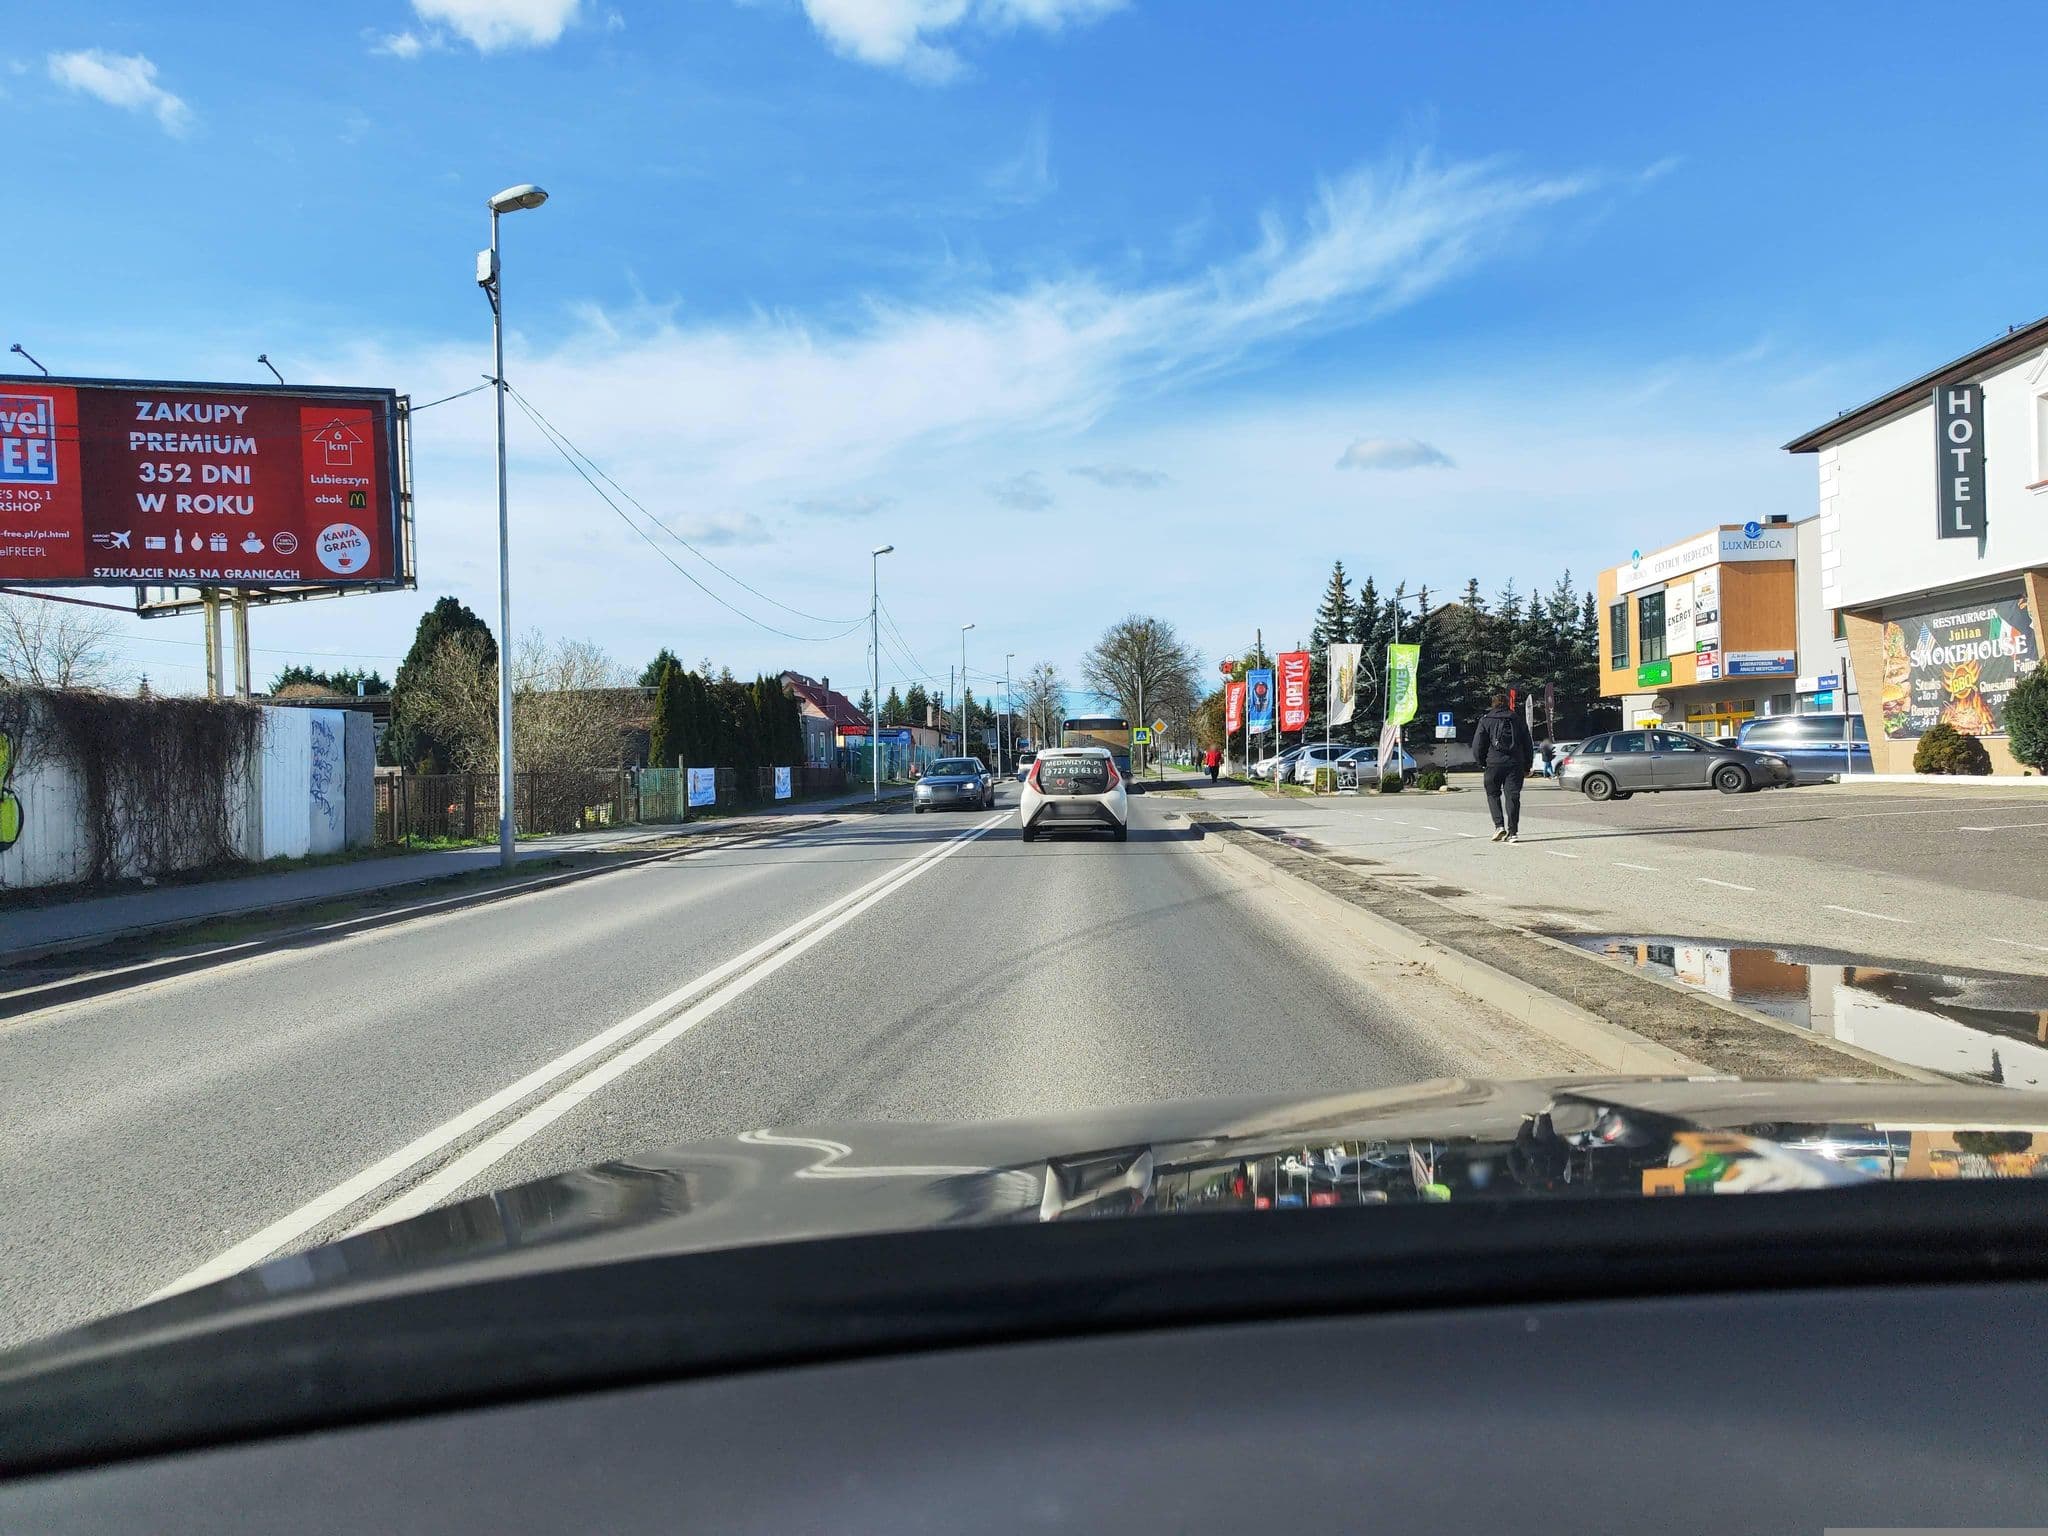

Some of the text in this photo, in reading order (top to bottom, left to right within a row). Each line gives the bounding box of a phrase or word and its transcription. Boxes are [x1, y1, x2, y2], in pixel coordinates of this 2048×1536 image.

[135, 401, 248, 425] ZAKUPY
[334, 431, 342, 440] 6
[130, 431, 257, 455] PREMIUM
[329, 441, 349, 451] km
[1948, 389, 1972, 531] HOTEL
[138, 463, 251, 485] 352 DNI
[310, 474, 369, 487] Lubieszyn
[18, 490, 43, 500] NO.
[46, 490, 52, 500] 1
[315, 494, 343, 504] obok
[136, 493, 255, 515] W ROKU
[323, 528, 357, 542] KAWA
[324, 539, 362, 553] GRATIS
[1722, 538, 1782, 550] LUXMEDICA
[93, 567, 300, 579] SZUKAJCIE NAS NA GRANICACH
[1667, 608, 1691, 626] ENERGY
[1932, 608, 1998, 629] RESTAURACJA
[1948, 627, 1982, 641] Julian
[1910, 634, 2028, 668] SMOKEHOUSE
[1285, 660, 1304, 707] OPTYK
[1952, 674, 1973, 692] BBQ
[1992, 694, 2001, 705] 30
[1441, 714, 1450, 724] P
[1052, 767, 1066, 775] 727
